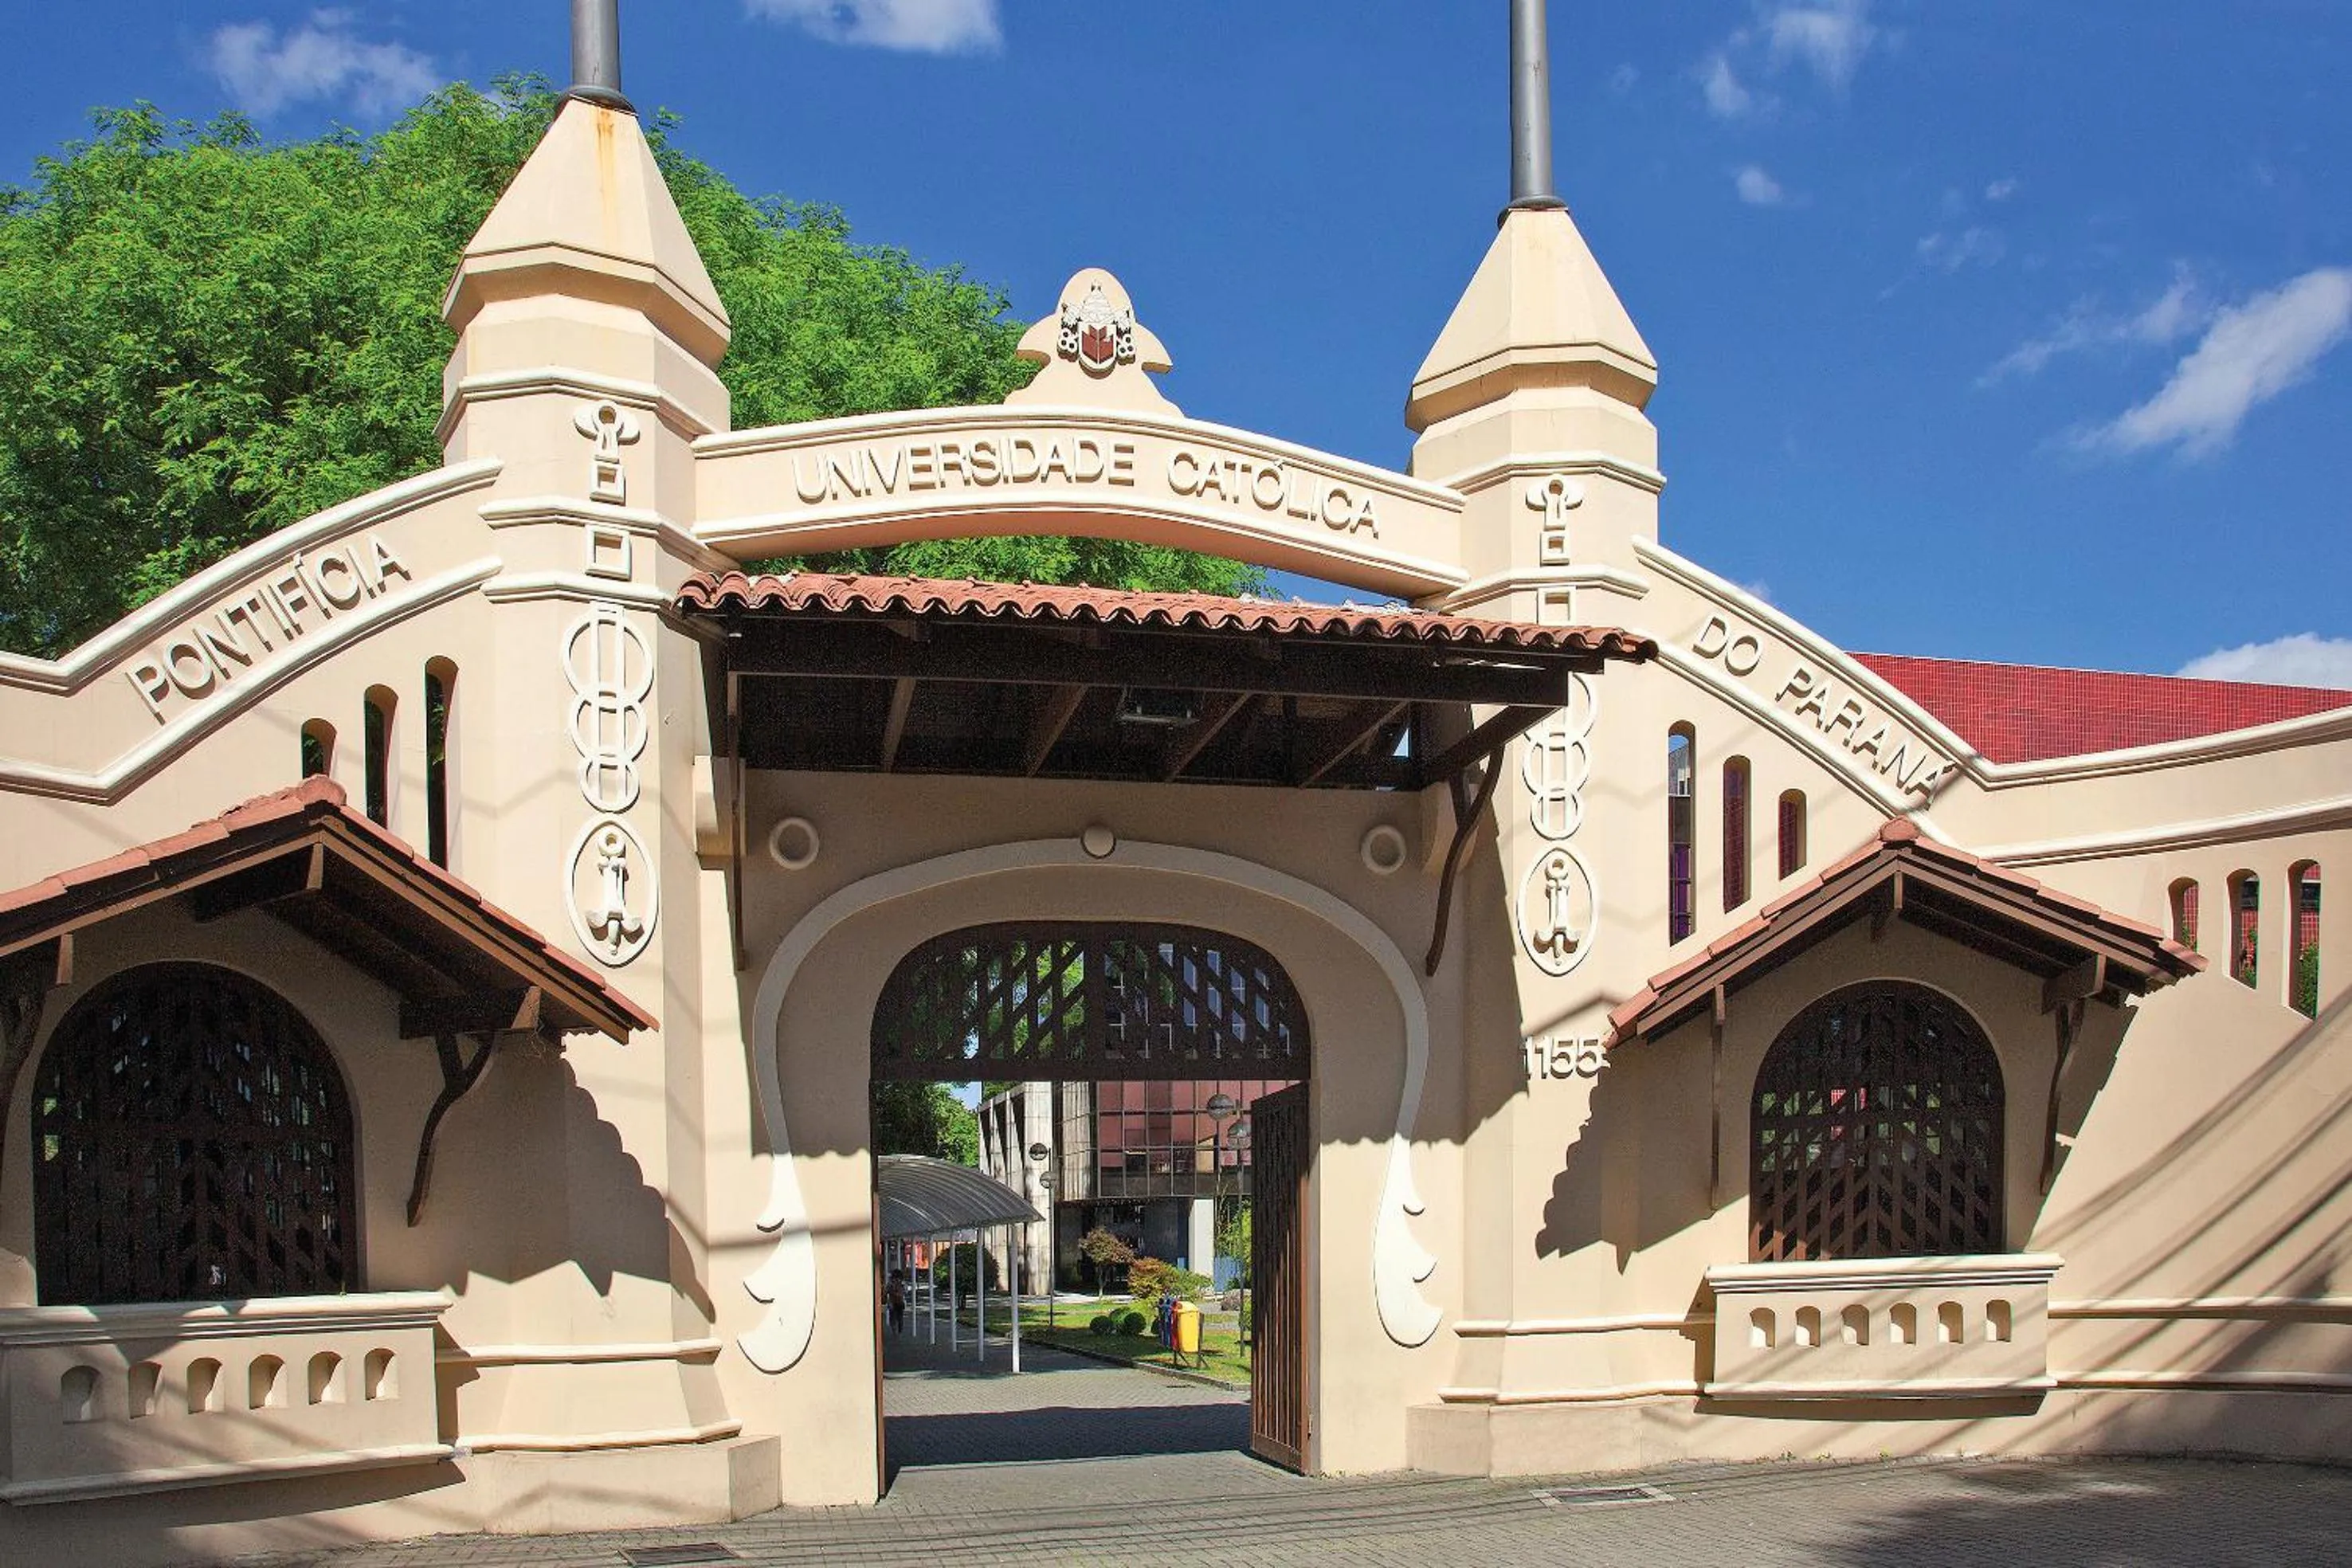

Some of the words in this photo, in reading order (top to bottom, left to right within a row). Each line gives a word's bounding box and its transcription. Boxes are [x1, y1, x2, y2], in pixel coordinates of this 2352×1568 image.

[793, 437, 1135, 504] UNIVERSIDADE
[1167, 452, 1380, 539] CATÓLICA
[125, 536, 412, 724] PONTIFÍCIA
[1692, 612, 1762, 676] DO
[1520, 1036, 1602, 1080] 1155
